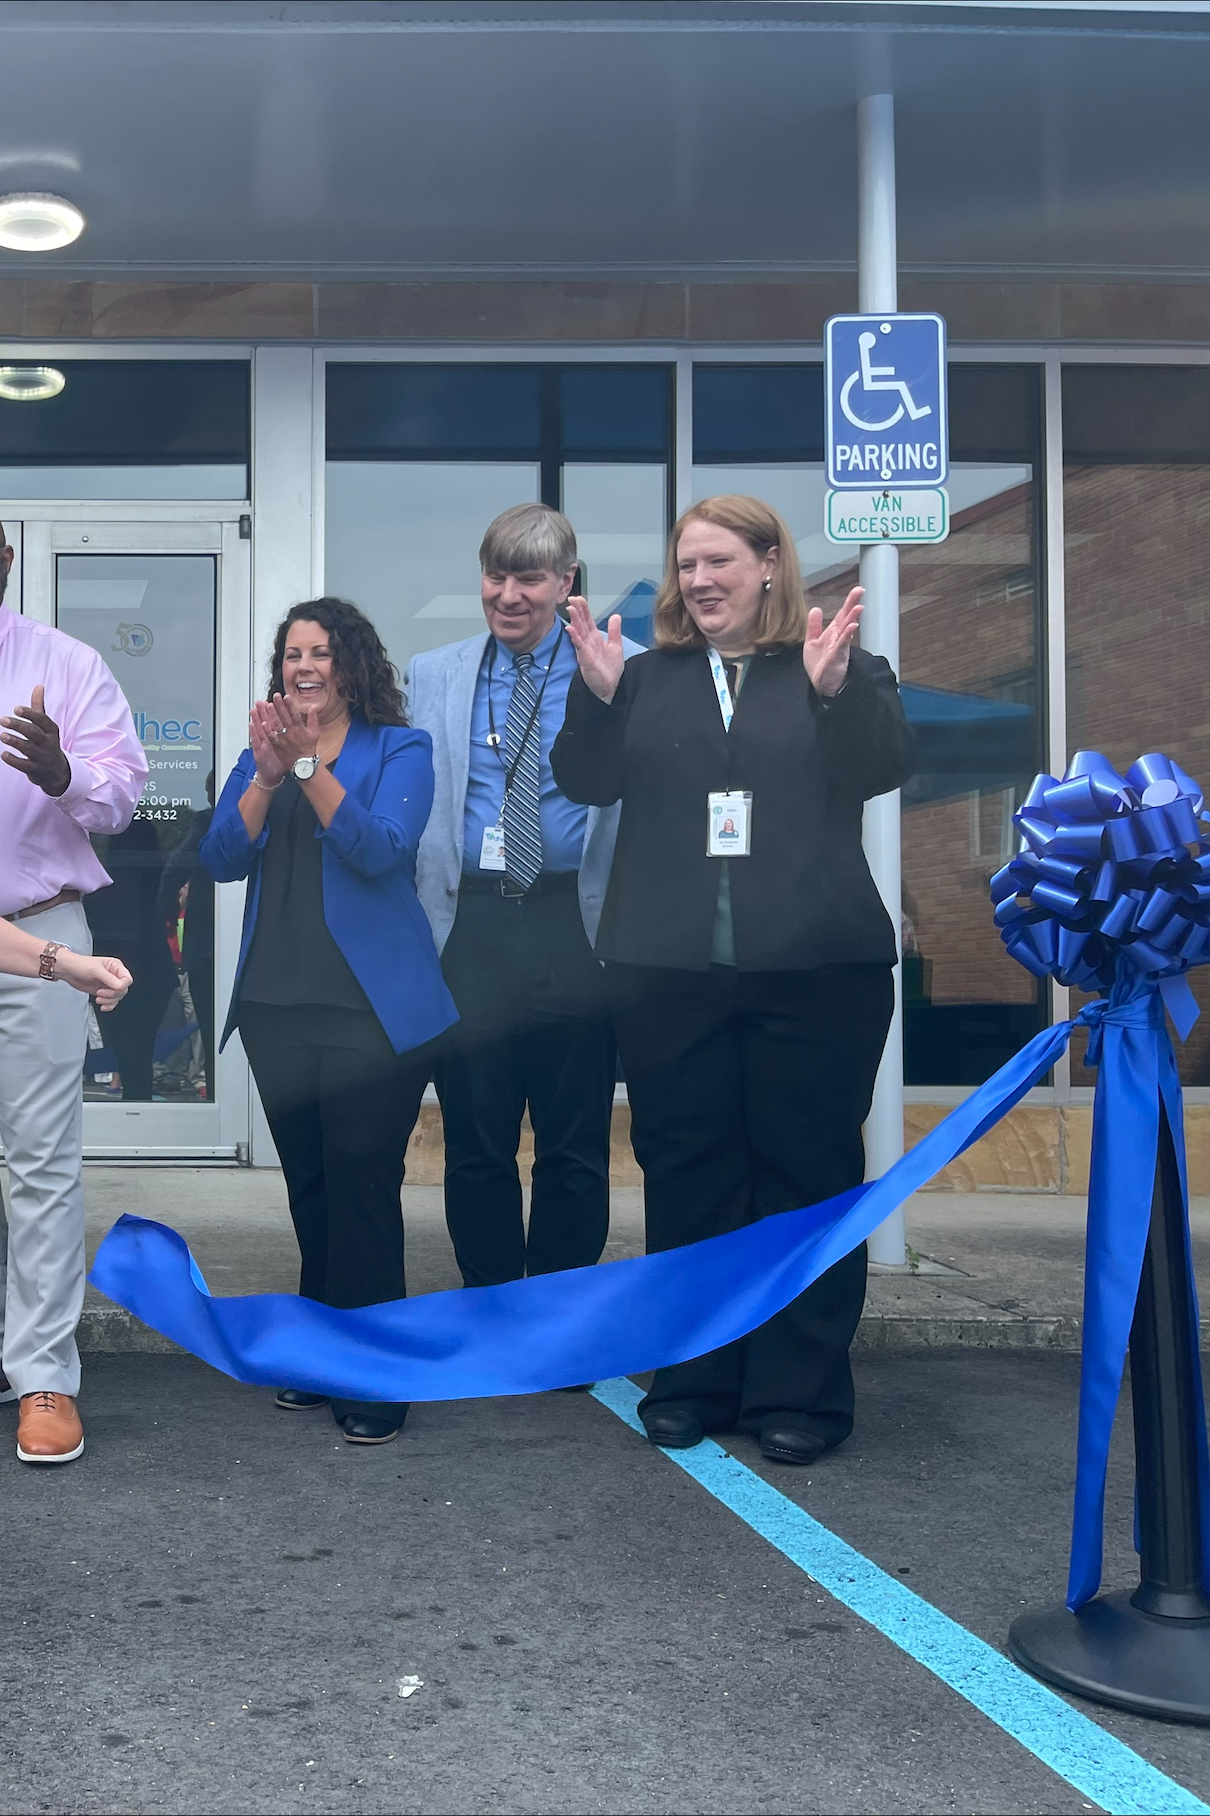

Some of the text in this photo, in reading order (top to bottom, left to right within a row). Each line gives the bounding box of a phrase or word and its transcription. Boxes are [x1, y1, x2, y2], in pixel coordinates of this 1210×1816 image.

[836, 443, 938, 471] PARKING
[871, 496, 902, 512] VAN
[837, 517, 936, 533] ACCESSIBLE
[148, 760, 198, 770] Services
[138, 796, 192, 808] 5:00 pm
